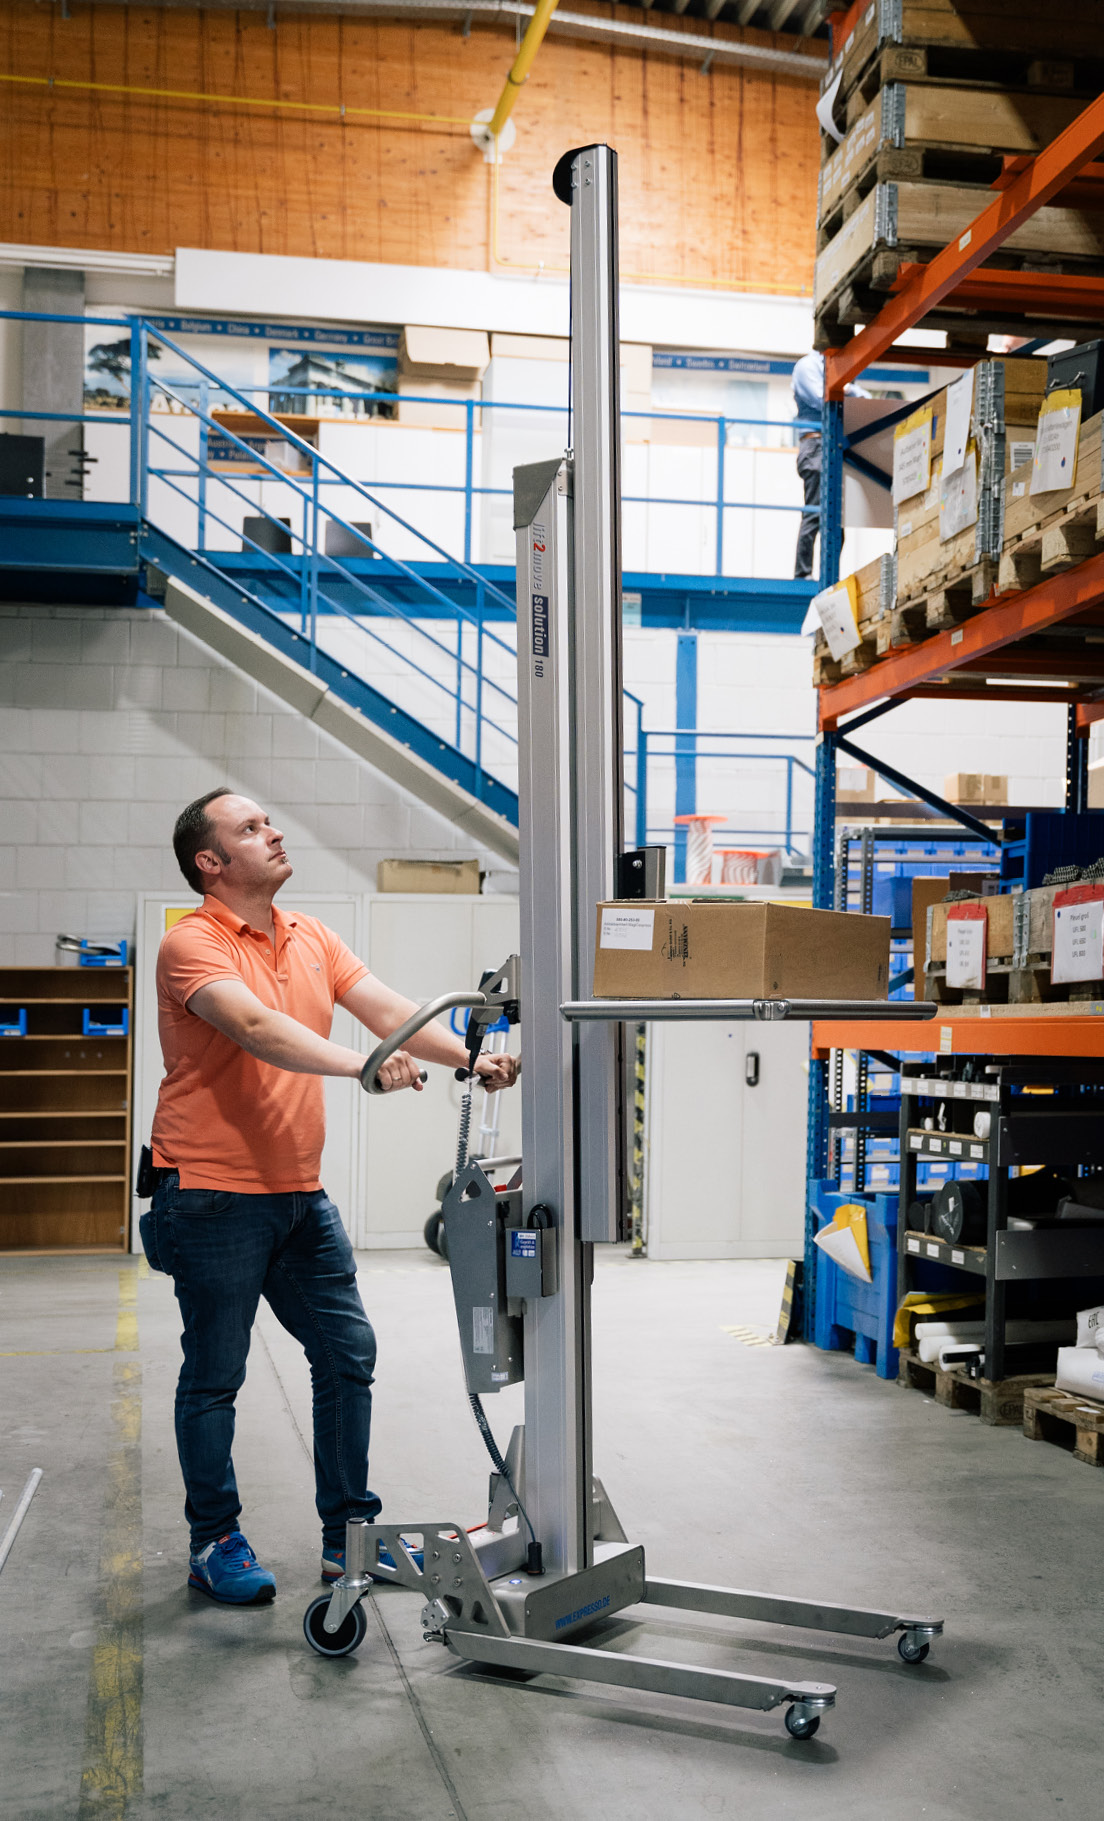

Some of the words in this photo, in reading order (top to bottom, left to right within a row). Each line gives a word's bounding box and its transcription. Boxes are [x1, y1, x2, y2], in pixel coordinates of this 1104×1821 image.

[180, 319, 212, 333] Belgium
[227, 323, 250, 335] China
[265, 326, 299, 339] Denmark
[314, 330, 348, 343] Germany
[728, 360, 770, 372] Switzerland
[533, 522, 546, 591] lift2move
[534, 596, 547, 654] solution
[535, 659, 544, 678] 180
[555, 1595, 610, 1630] WWW.EXPRESSO.DE
